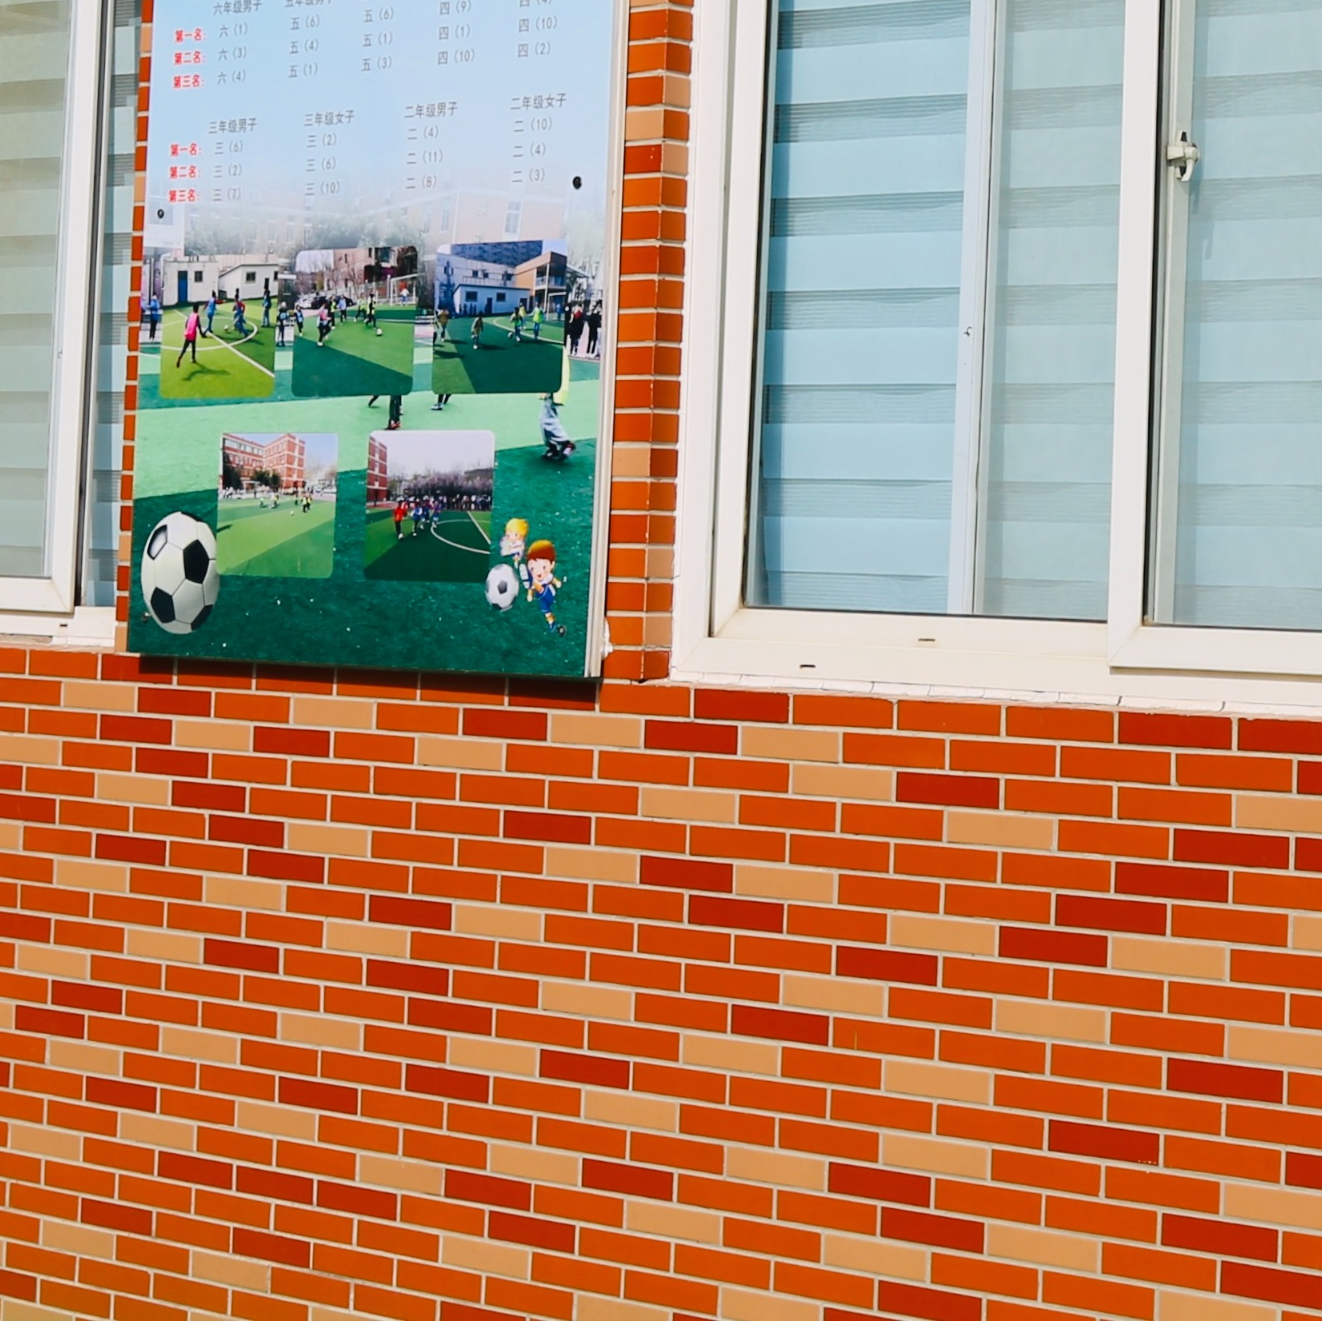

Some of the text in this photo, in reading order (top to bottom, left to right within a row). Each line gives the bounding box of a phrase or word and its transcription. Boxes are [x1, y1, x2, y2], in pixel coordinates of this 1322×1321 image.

[209, 92, 567, 135] 三年级男子 三年级女子 二年级男子 二年级女子
